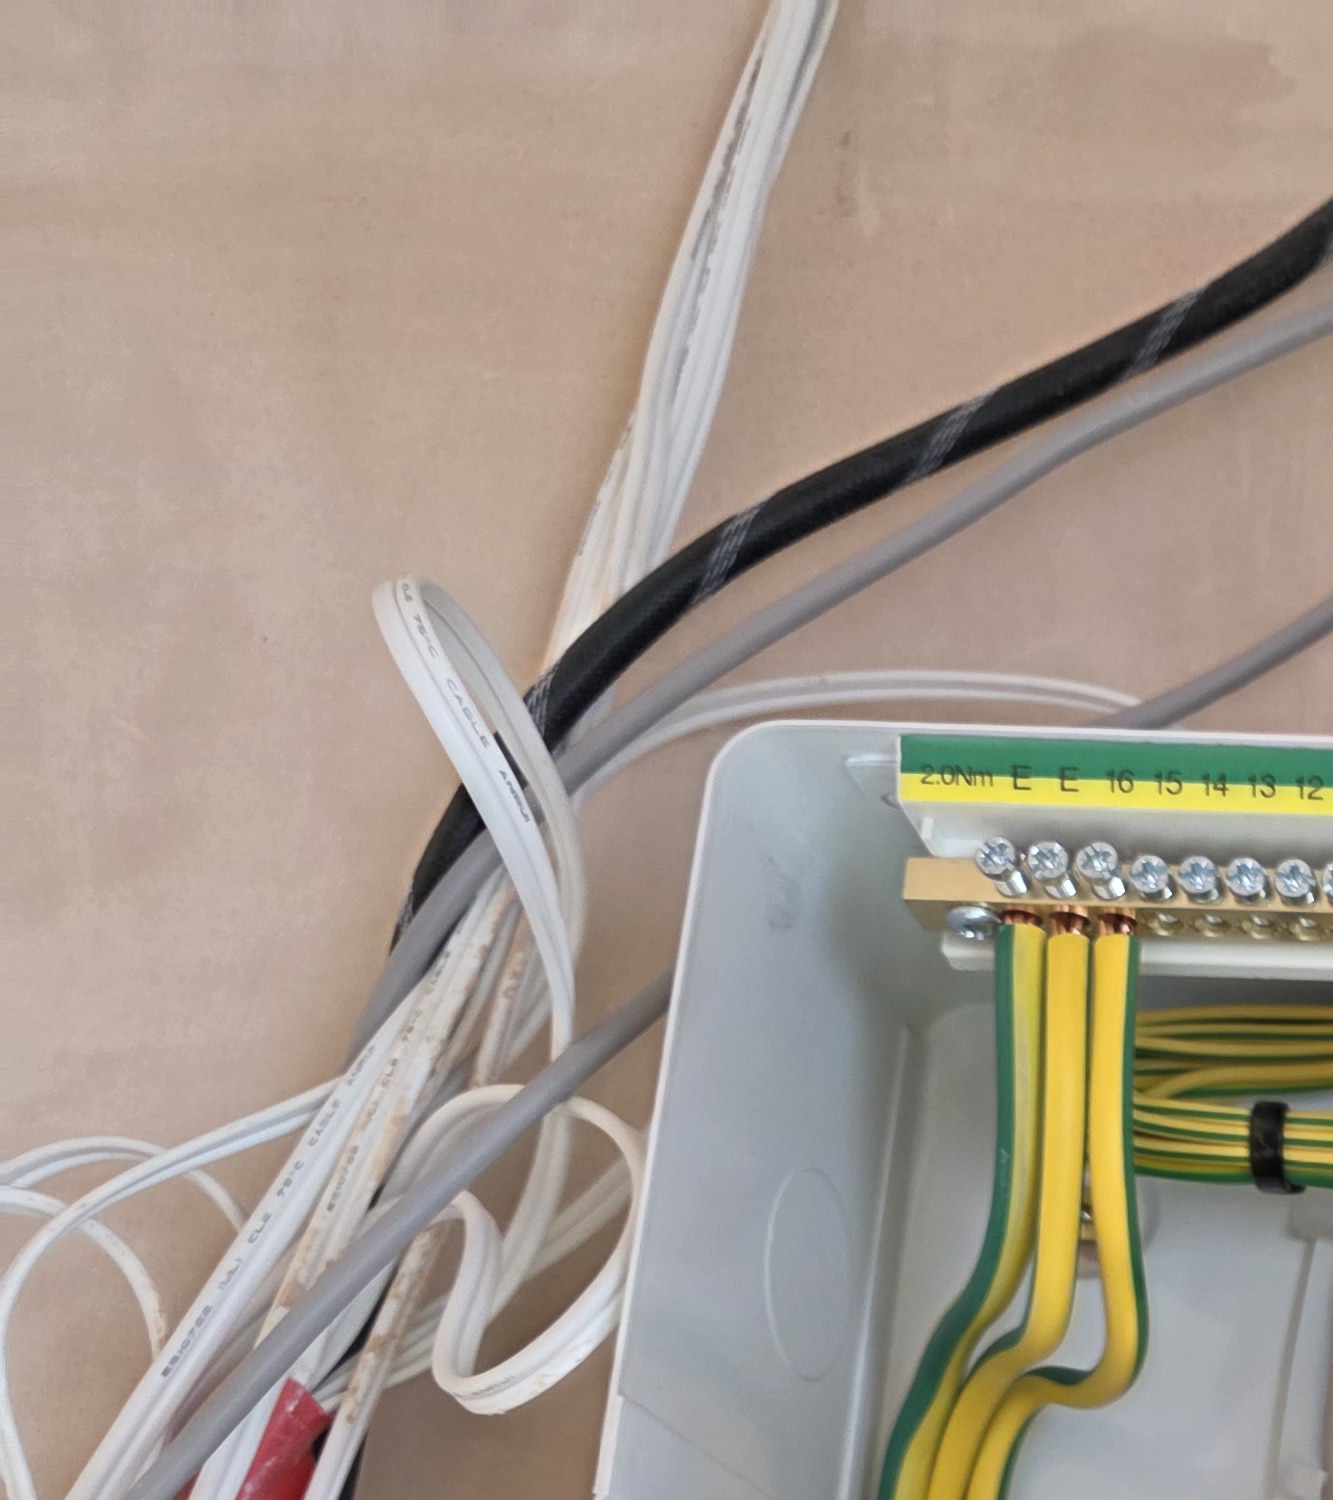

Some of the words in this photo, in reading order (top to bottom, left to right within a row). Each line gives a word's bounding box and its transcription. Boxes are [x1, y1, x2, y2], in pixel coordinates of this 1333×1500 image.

[921, 765, 994, 789] 2.0Nm
[1012, 765, 1033, 791] E
[1059, 768, 1080, 793] E
[1107, 769, 1134, 794] 16
[1155, 770, 1183, 795] 15
[1202, 772, 1229, 797] 14
[1250, 773, 1277, 798] 13
[1297, 775, 1324, 800] 12
